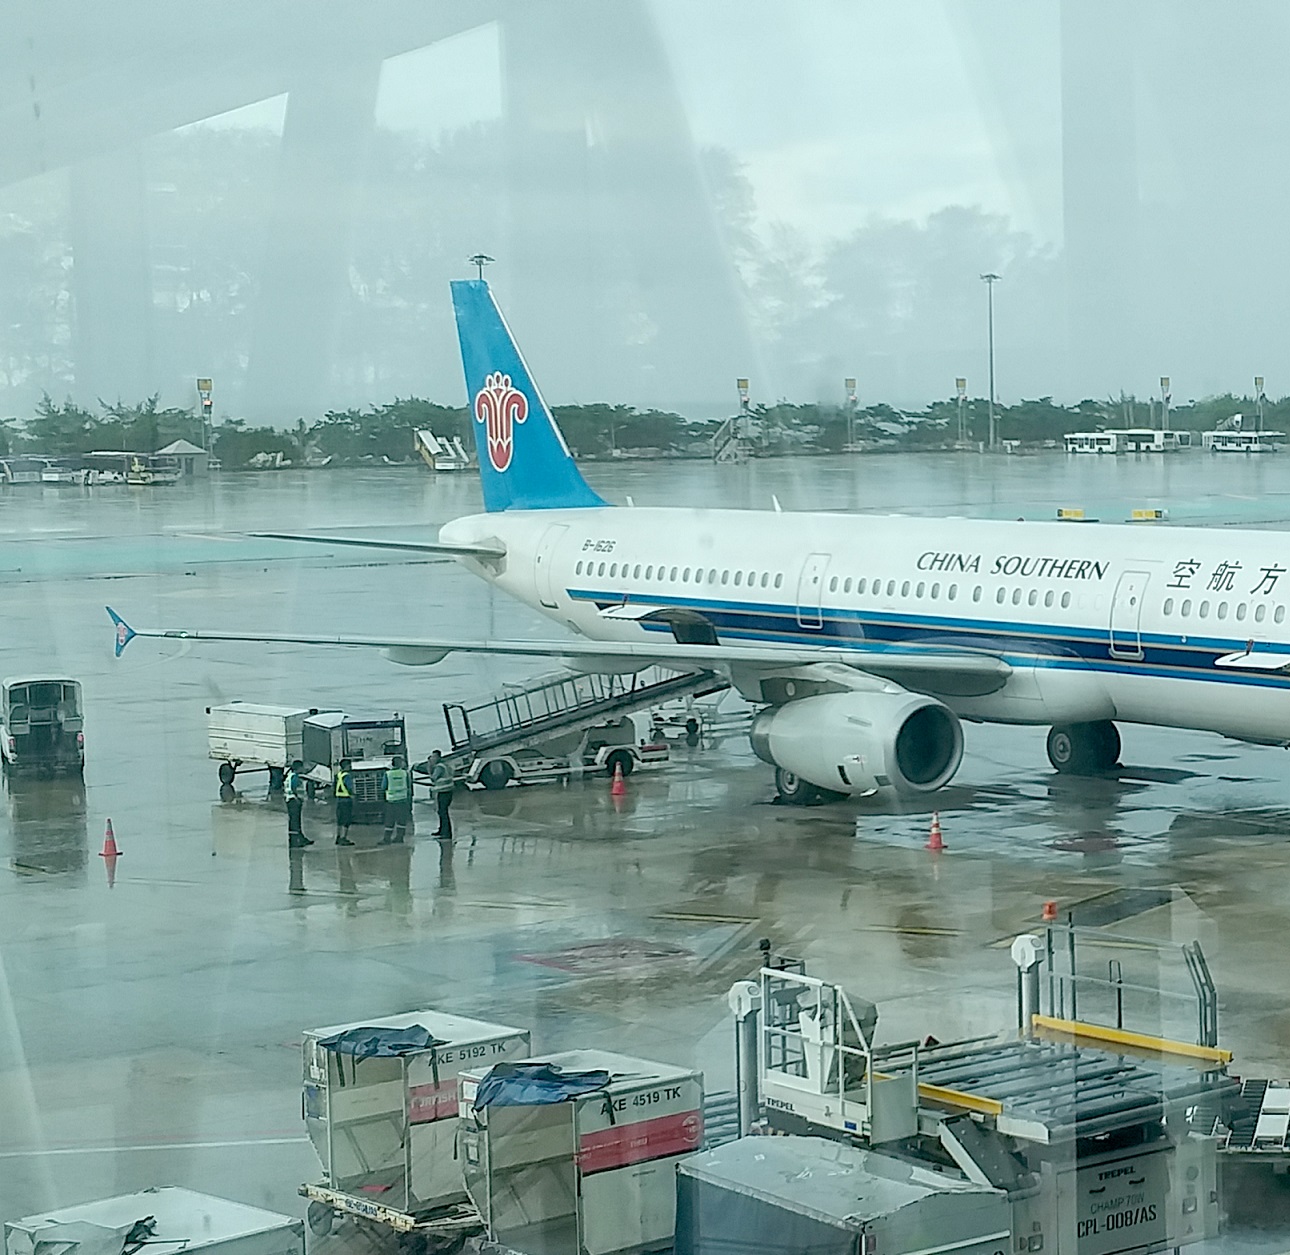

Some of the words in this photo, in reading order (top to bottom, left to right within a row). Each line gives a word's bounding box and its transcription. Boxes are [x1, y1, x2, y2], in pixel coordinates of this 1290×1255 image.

[582, 539, 616, 553] B-1626
[917, 552, 981, 573] CHINA
[990, 556, 1110, 580] SOUTHERN
[460, 1047, 486, 1061] 5192
[490, 1041, 507, 1054] TK
[633, 1091, 660, 1106] 4519
[664, 1086, 681, 1101] TK
[766, 1097, 796, 1112] TREPEL
[1098, 1166, 1137, 1181] TREPEL
[1090, 1196, 1125, 1215] CHAMP
[1077, 1204, 1157, 1238] CPL-008/AS
